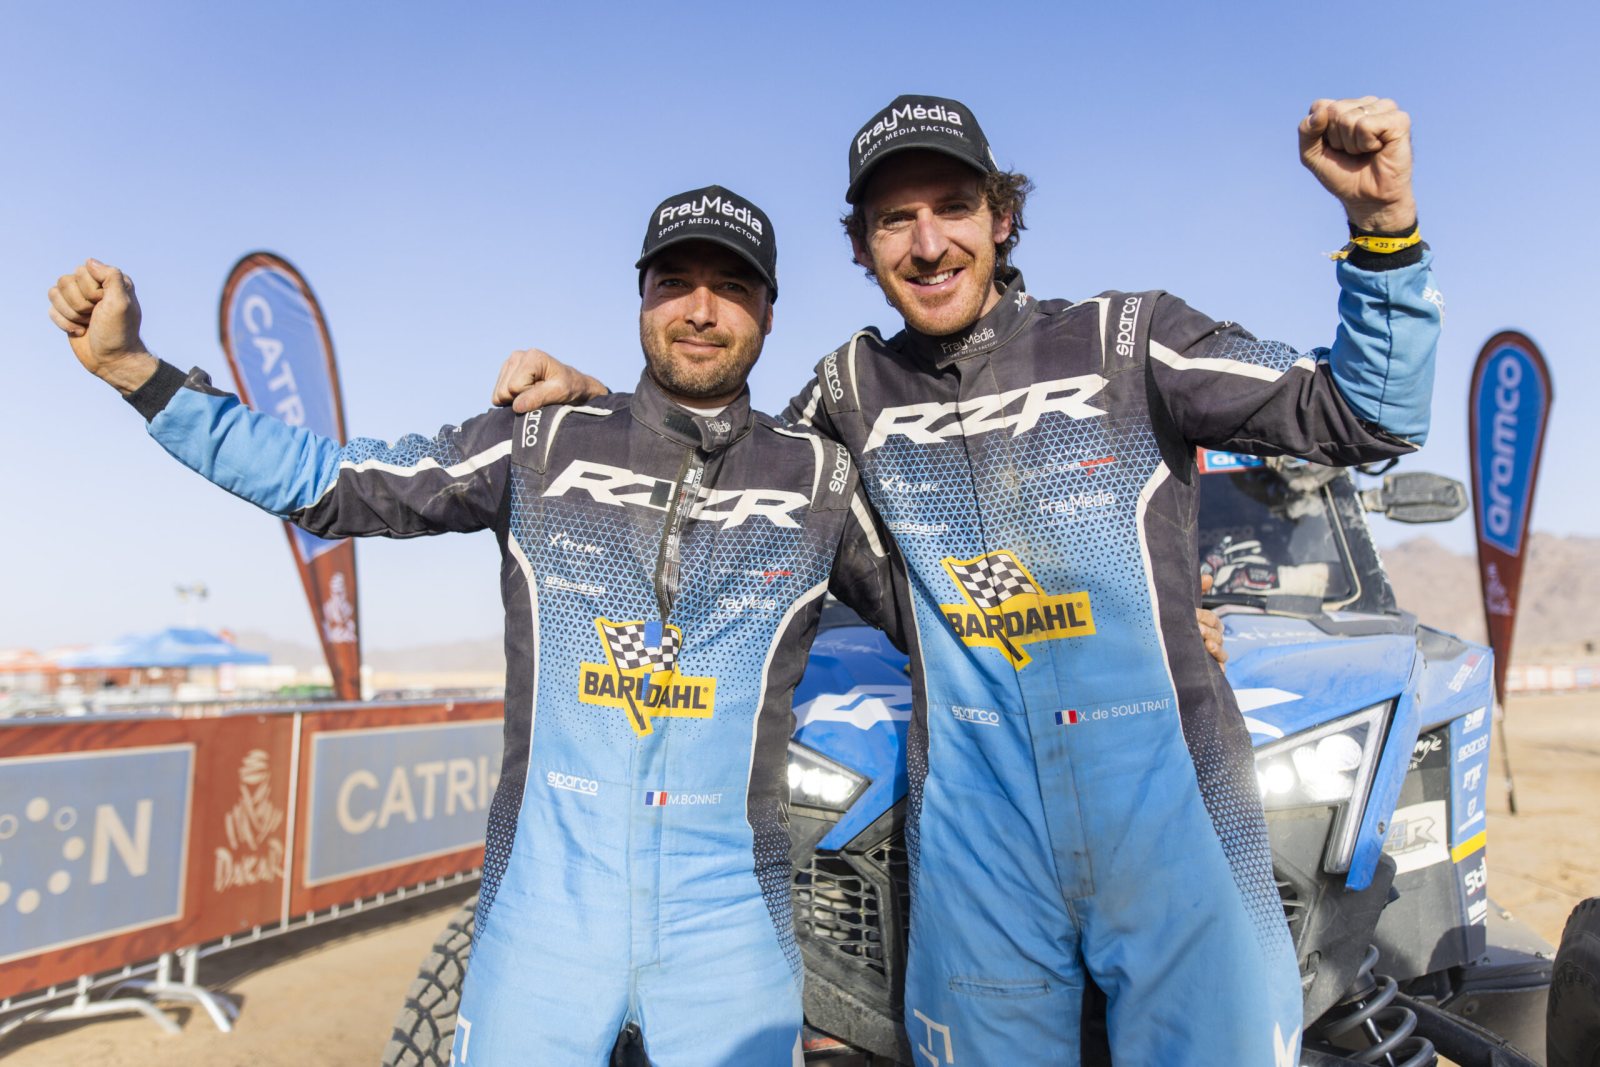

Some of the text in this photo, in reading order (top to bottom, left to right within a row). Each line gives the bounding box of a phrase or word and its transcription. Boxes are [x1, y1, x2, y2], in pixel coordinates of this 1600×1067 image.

[857, 103, 963, 154] FrayMédia
[859, 125, 965, 166] SPORT MEDIA FACTORY
[658, 195, 763, 236] FrayMédia
[658, 217, 761, 247] SPORT MEDIA FACTORY
[941, 327, 996, 354] FrayMédia
[1115, 296, 1143, 359] sparco
[242, 294, 306, 427] CATR
[521, 409, 543, 449] arco
[862, 373, 1111, 454] RZR
[1486, 354, 1523, 537] aramco
[945, 602, 1087, 639] BARDAHL
[951, 705, 1000, 727] sparco
[1091, 708, 1109, 721] de
[1111, 698, 1171, 718] SOULTRAIT
[336, 755, 491, 835] CATRI
[547, 771, 599, 796] sparco
